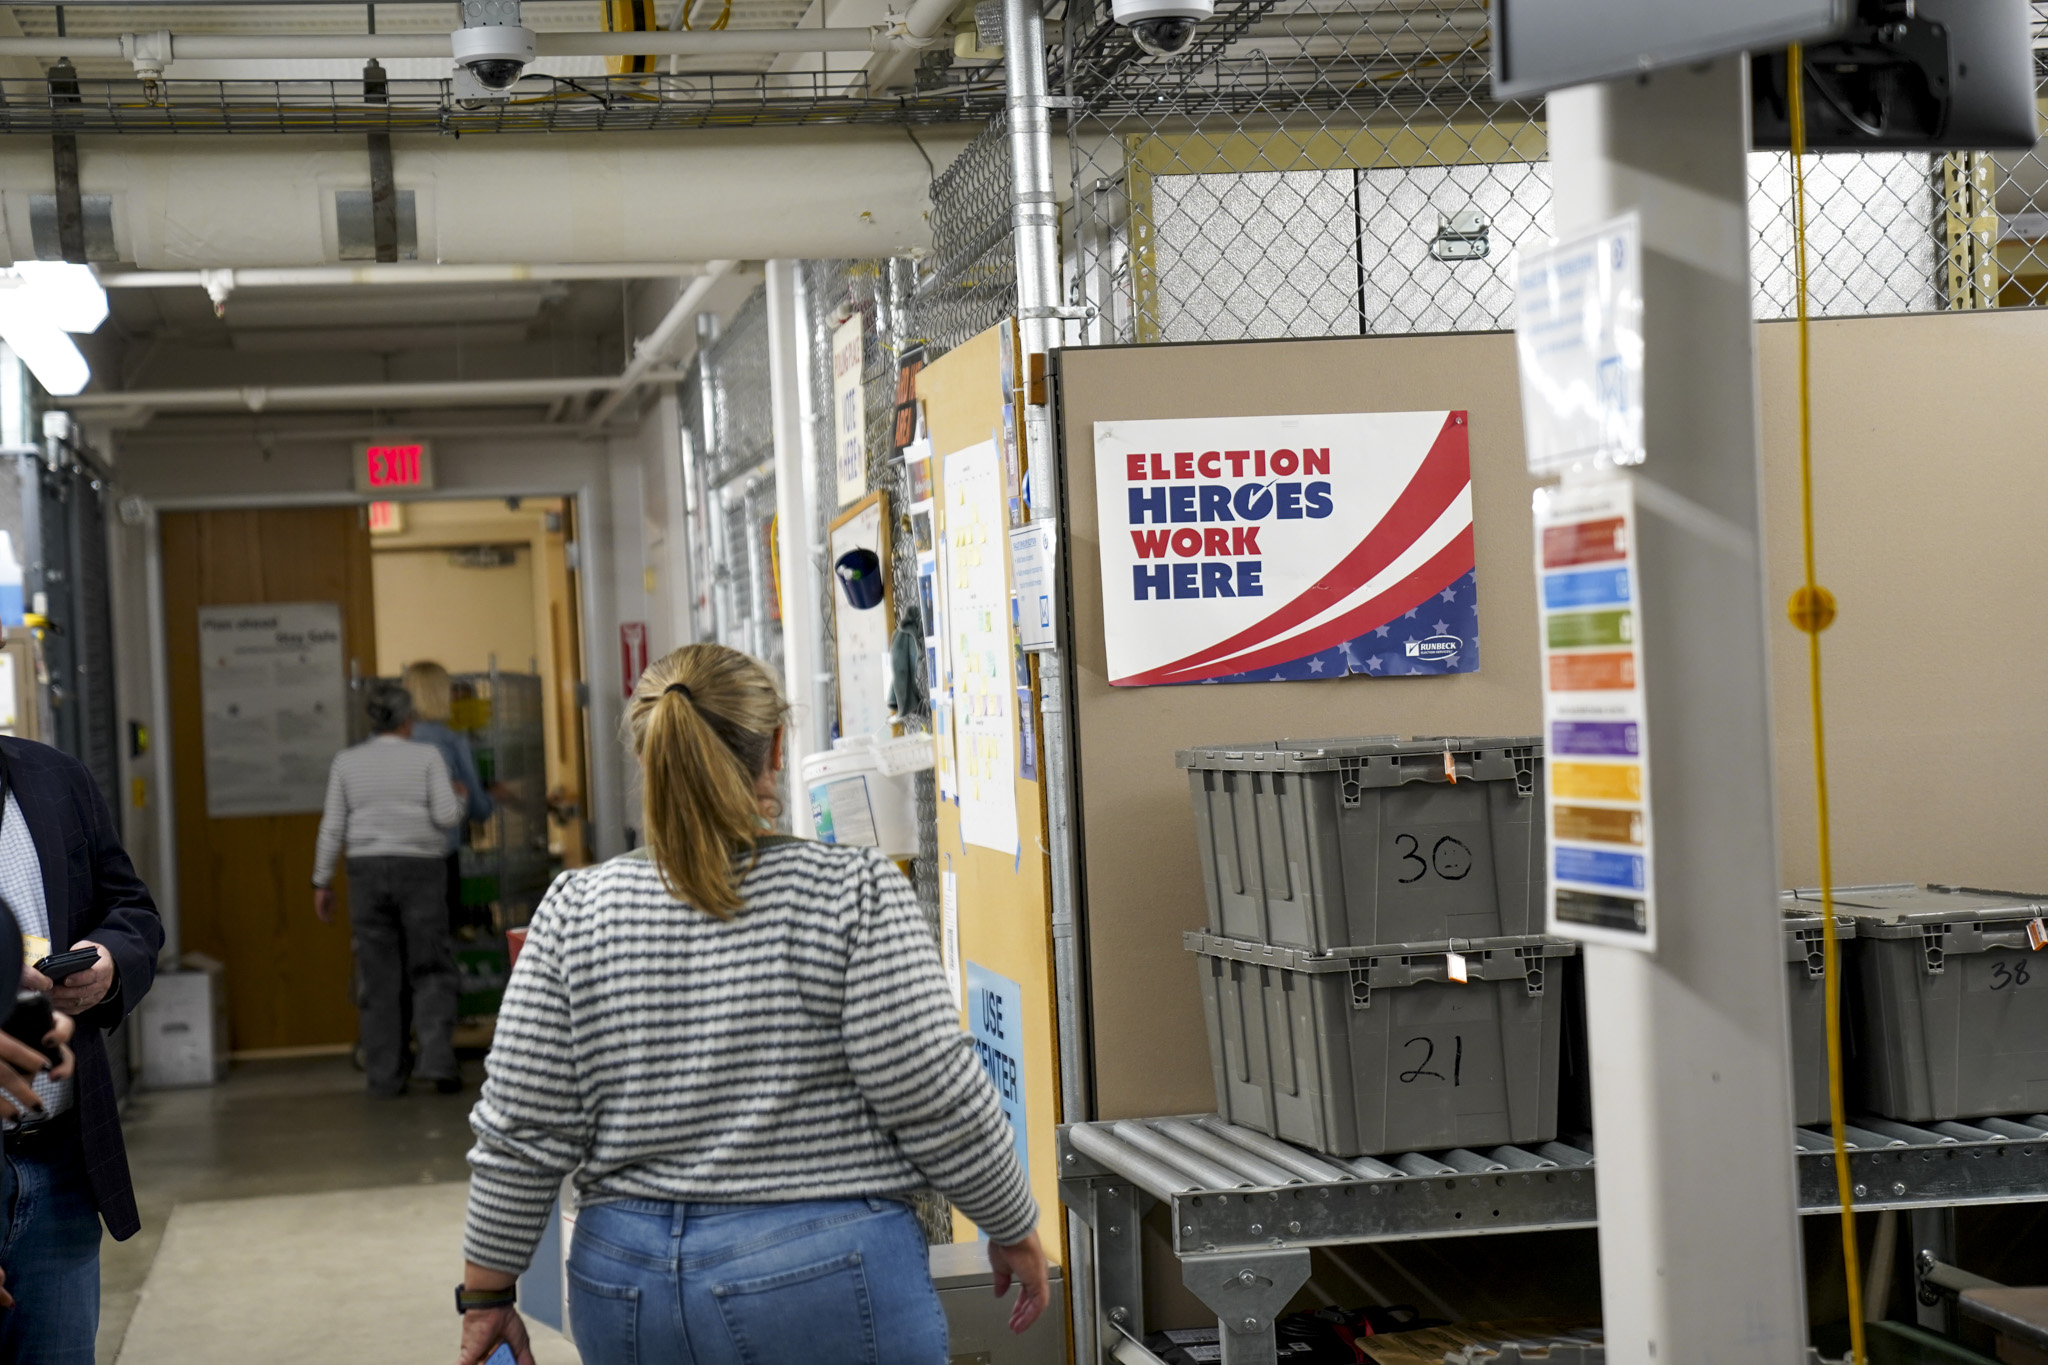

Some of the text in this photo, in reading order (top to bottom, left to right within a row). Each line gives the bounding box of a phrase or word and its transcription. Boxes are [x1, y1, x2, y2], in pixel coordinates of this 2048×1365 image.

[841, 388, 856, 434] VOTE
[367, 444, 423, 488] EXIT
[843, 438, 858, 483] HERE
[1126, 448, 1330, 481] ELECTION
[1128, 479, 1334, 524] HEROES
[1130, 526, 1262, 559] WORK
[1133, 561, 1263, 601] HERE
[1420, 642, 1456, 651] RUNBECK
[1395, 833, 1472, 883] 30
[1989, 959, 2030, 990] 38
[982, 987, 1004, 1040] USE
[1400, 1036, 1462, 1087] 21
